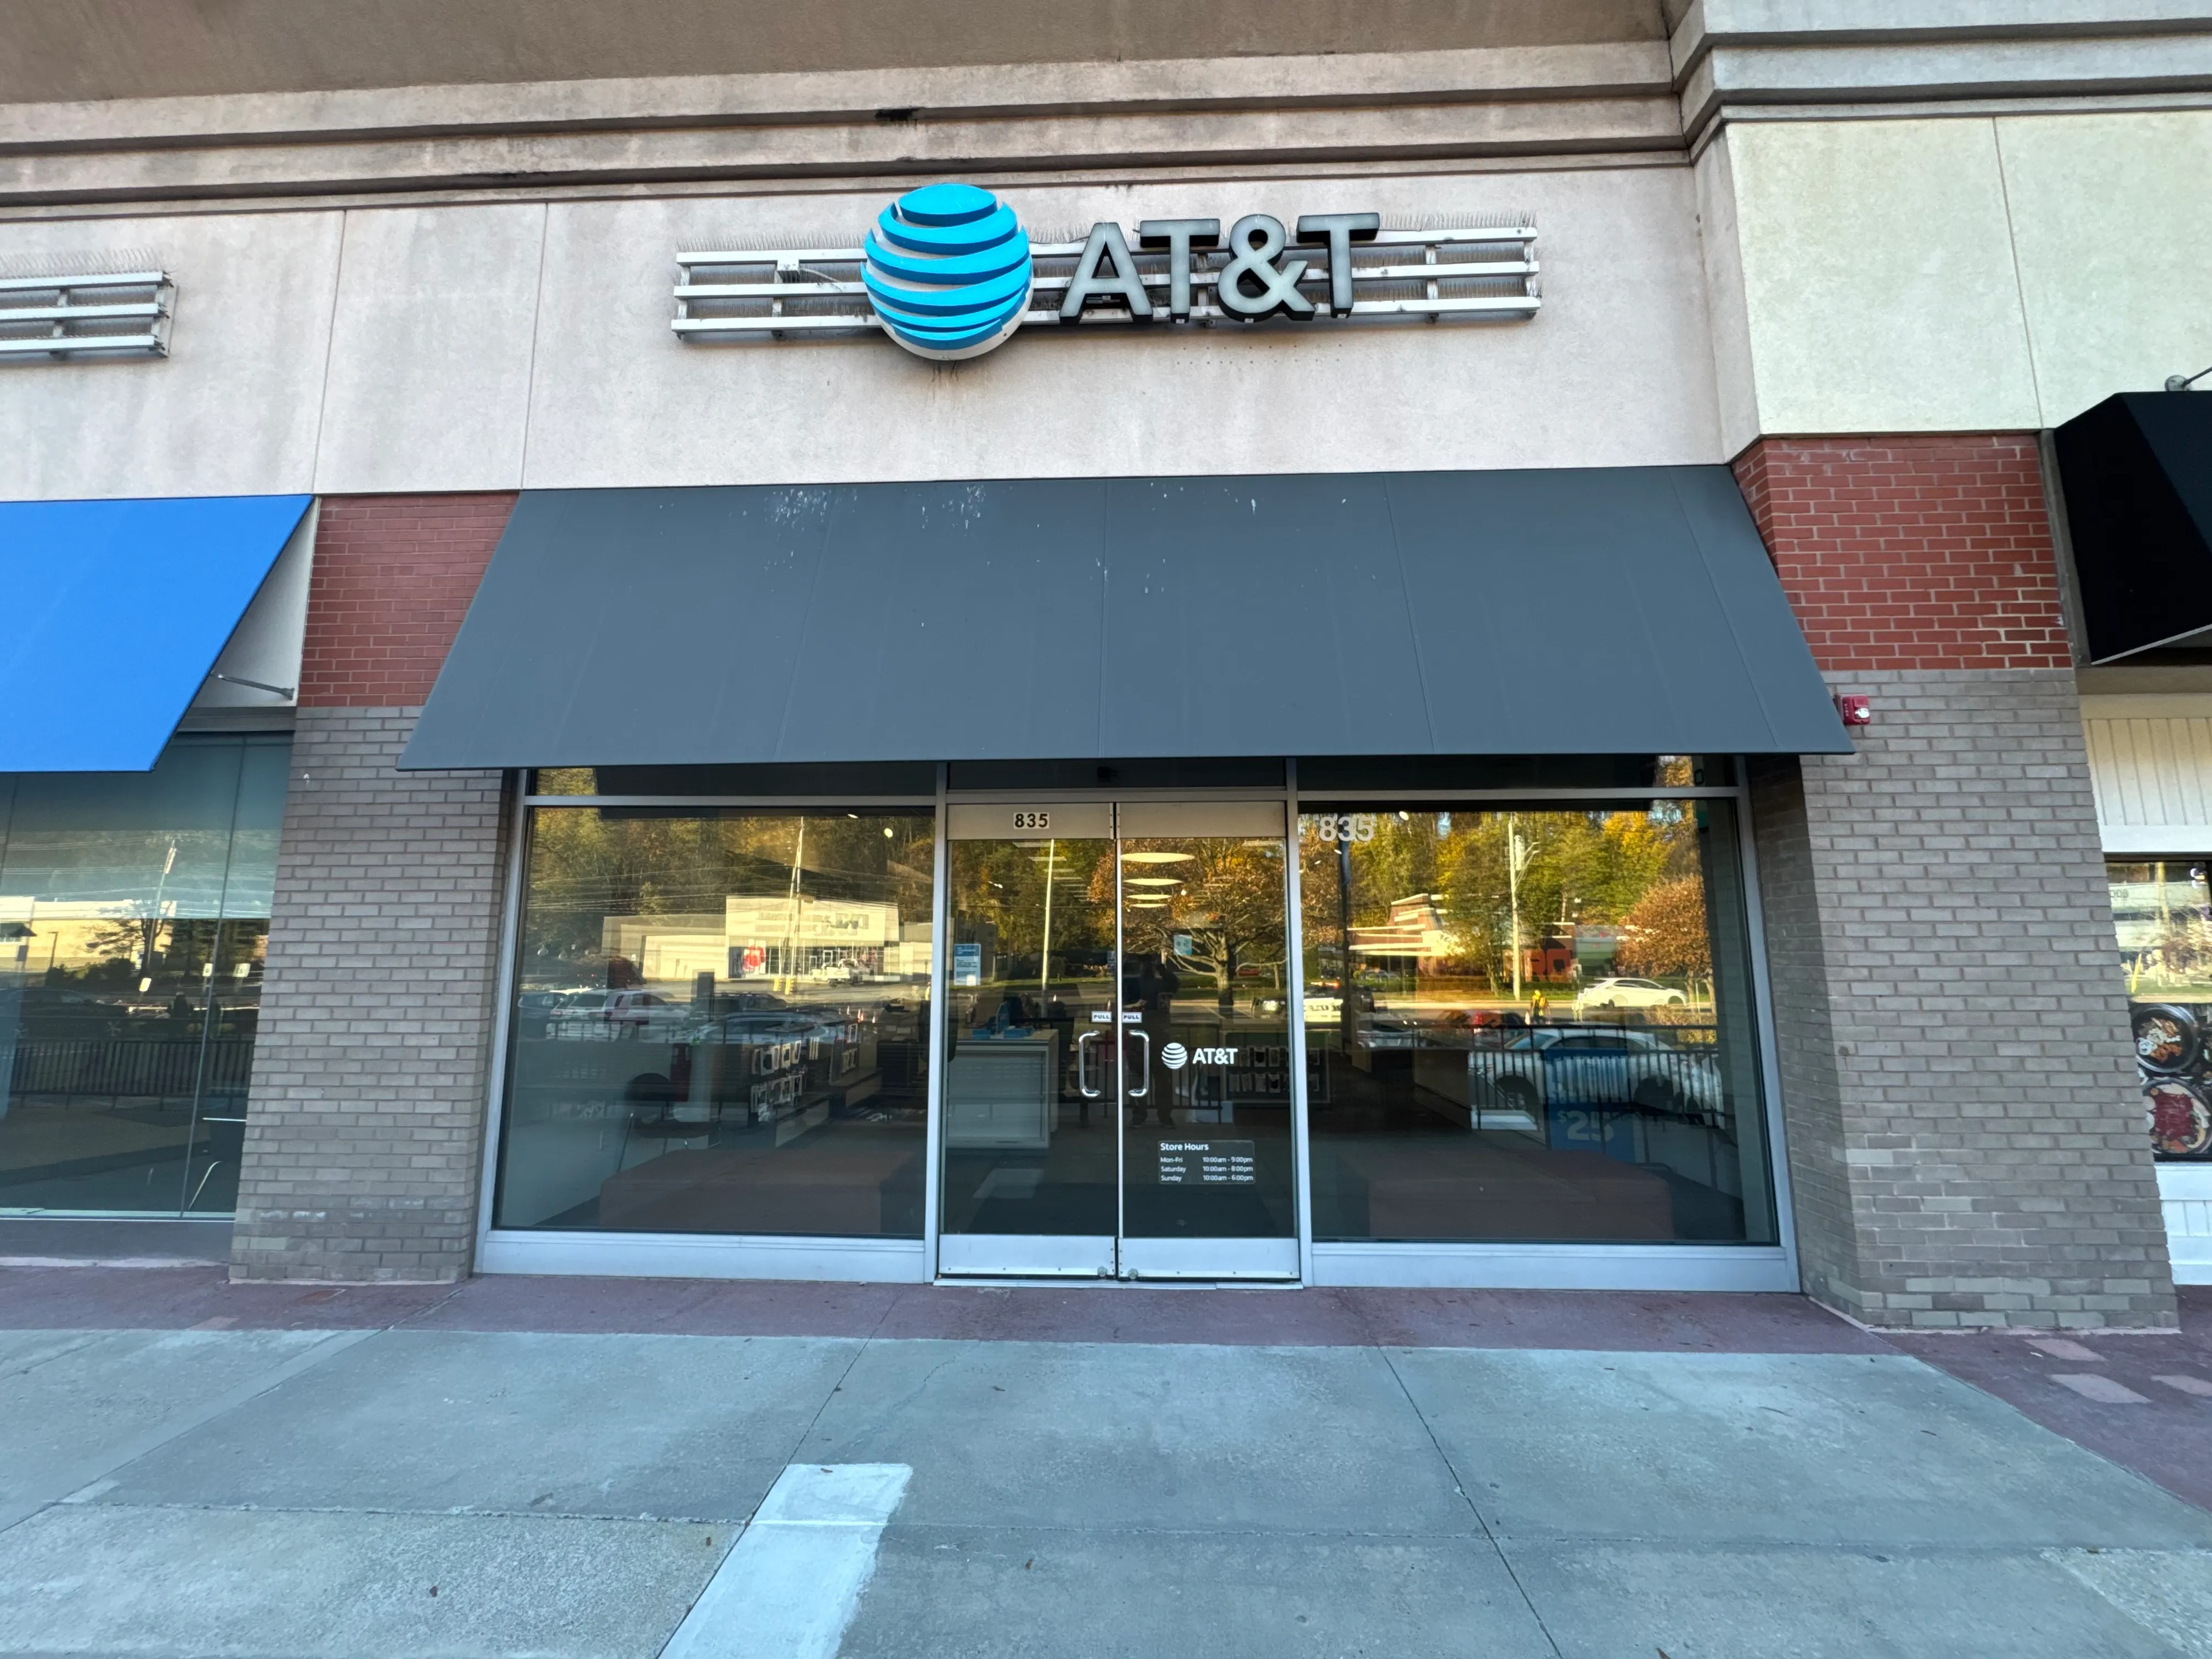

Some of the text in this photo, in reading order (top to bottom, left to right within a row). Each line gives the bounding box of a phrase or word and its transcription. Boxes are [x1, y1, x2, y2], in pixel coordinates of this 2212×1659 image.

[1059, 212, 1380, 325] AT&T
[1014, 813, 1048, 828] 835
[1319, 816, 1374, 842] 835
[1192, 1047, 1238, 1065] AT&T
[1160, 1143, 1209, 1151] Store Hours
